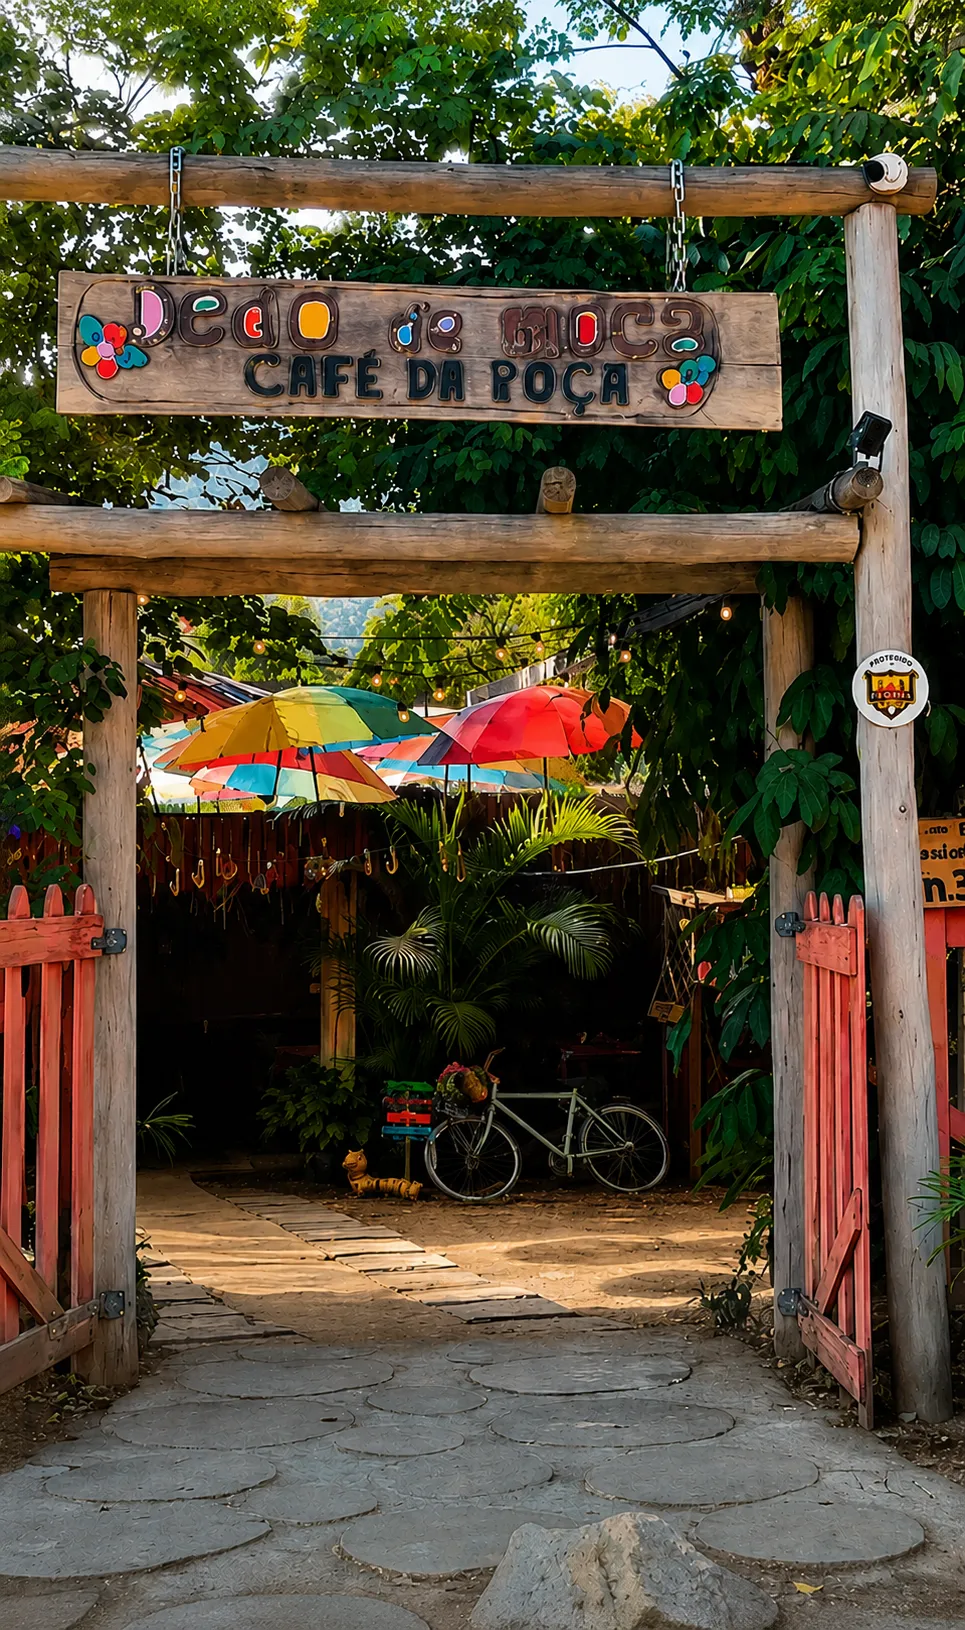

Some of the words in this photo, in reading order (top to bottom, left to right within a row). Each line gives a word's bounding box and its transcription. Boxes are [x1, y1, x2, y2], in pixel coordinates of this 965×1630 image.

[243, 350, 383, 399] CAFÉ
[406, 358, 466, 402] DA
[491, 360, 630, 416] POÇA
